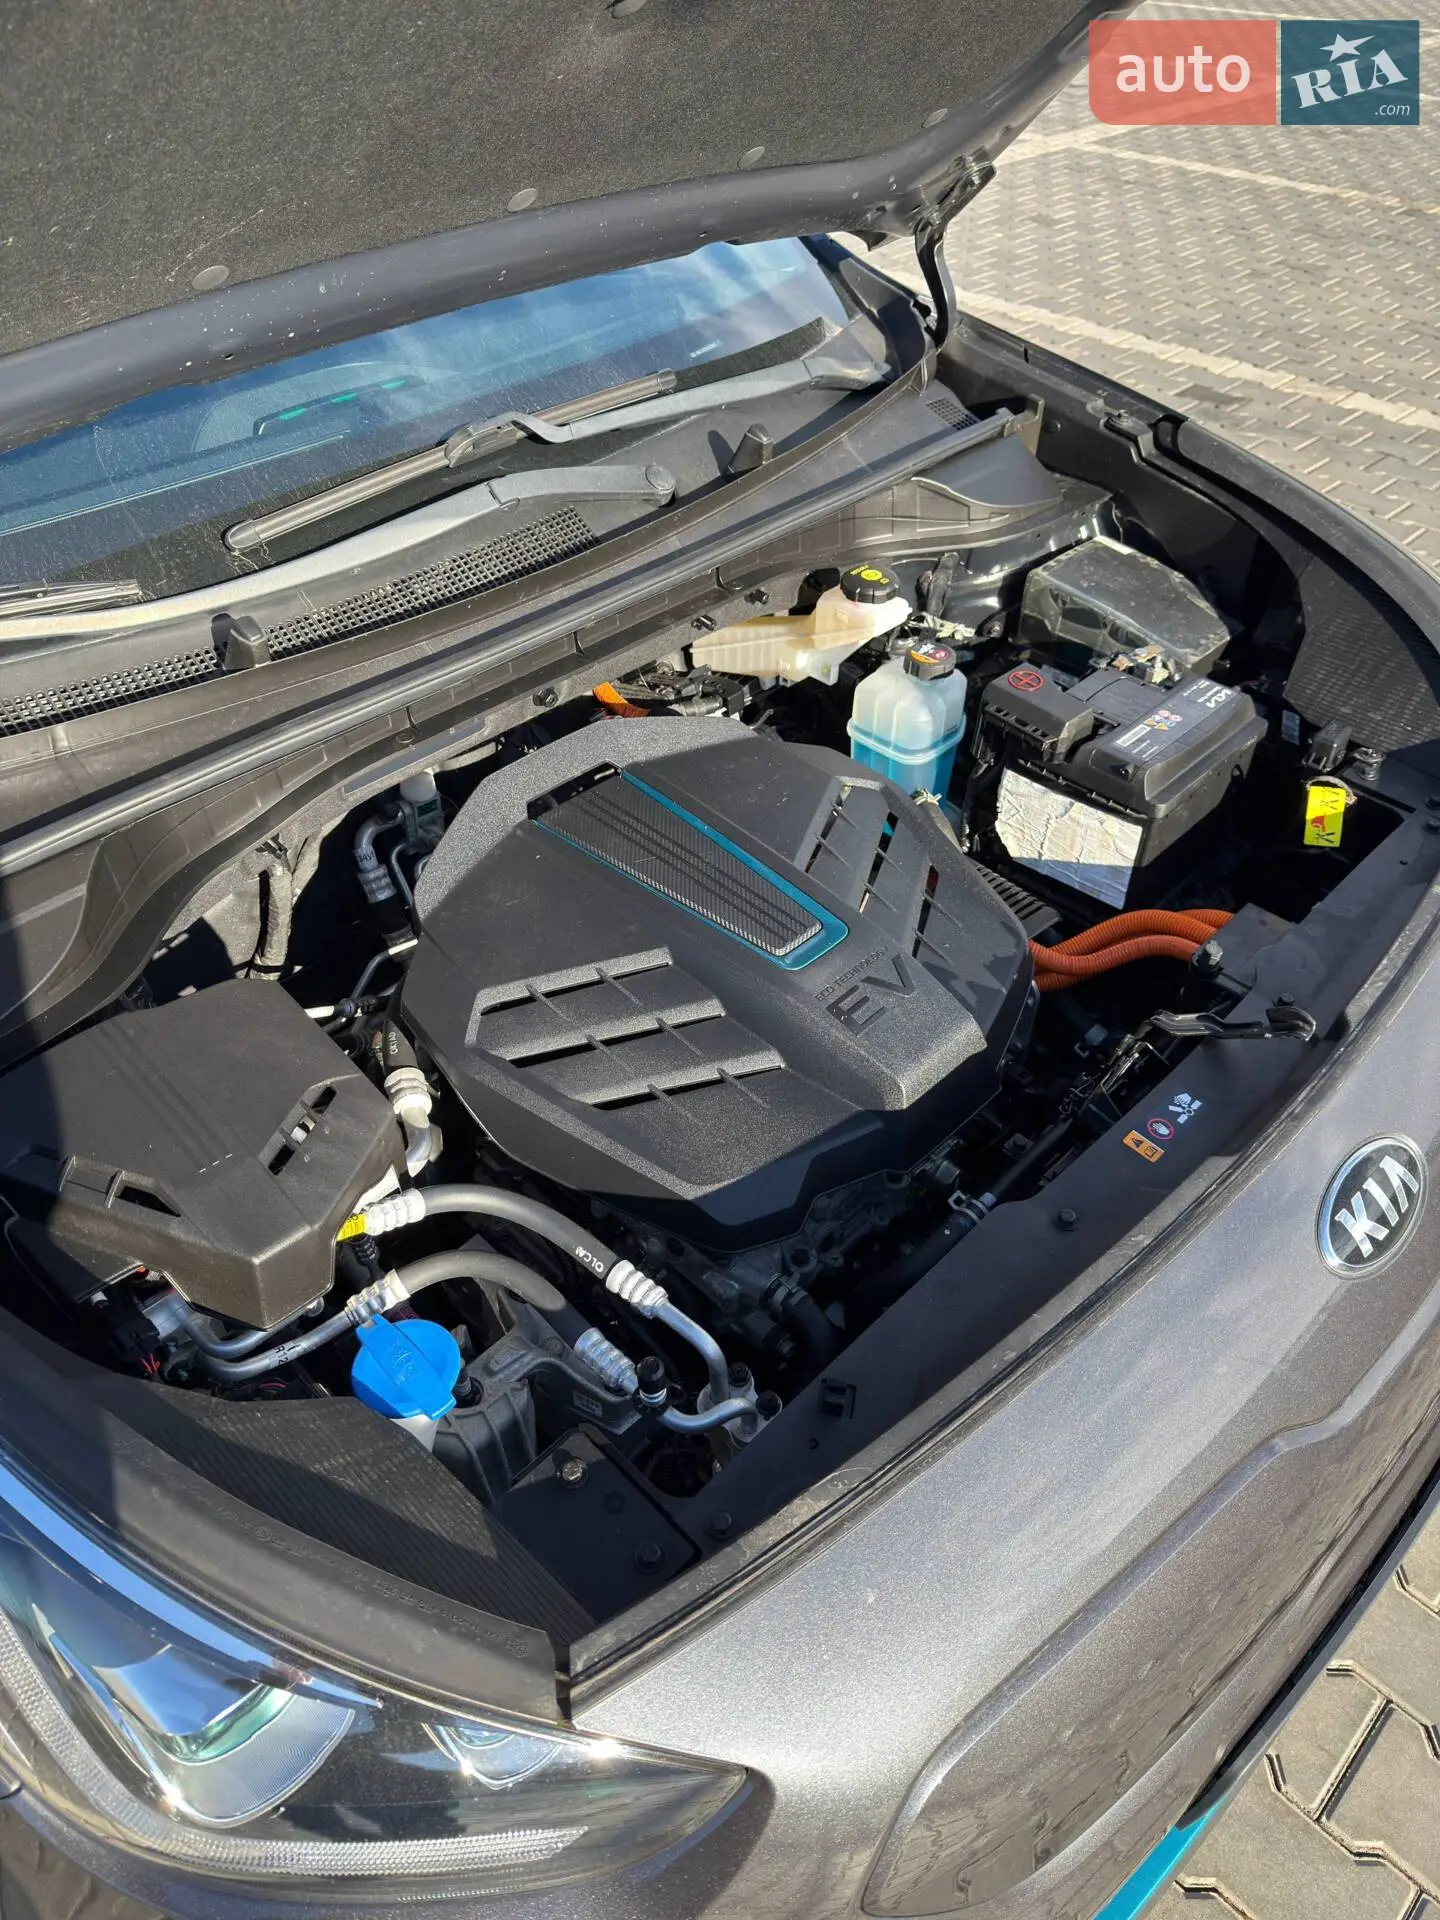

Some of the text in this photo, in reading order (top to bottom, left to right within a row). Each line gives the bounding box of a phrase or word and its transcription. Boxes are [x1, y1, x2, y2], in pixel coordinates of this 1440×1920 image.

[814, 984, 836, 1001] ECO
[825, 953, 917, 1036] EV
[1334, 1154, 1420, 1258] KIA
